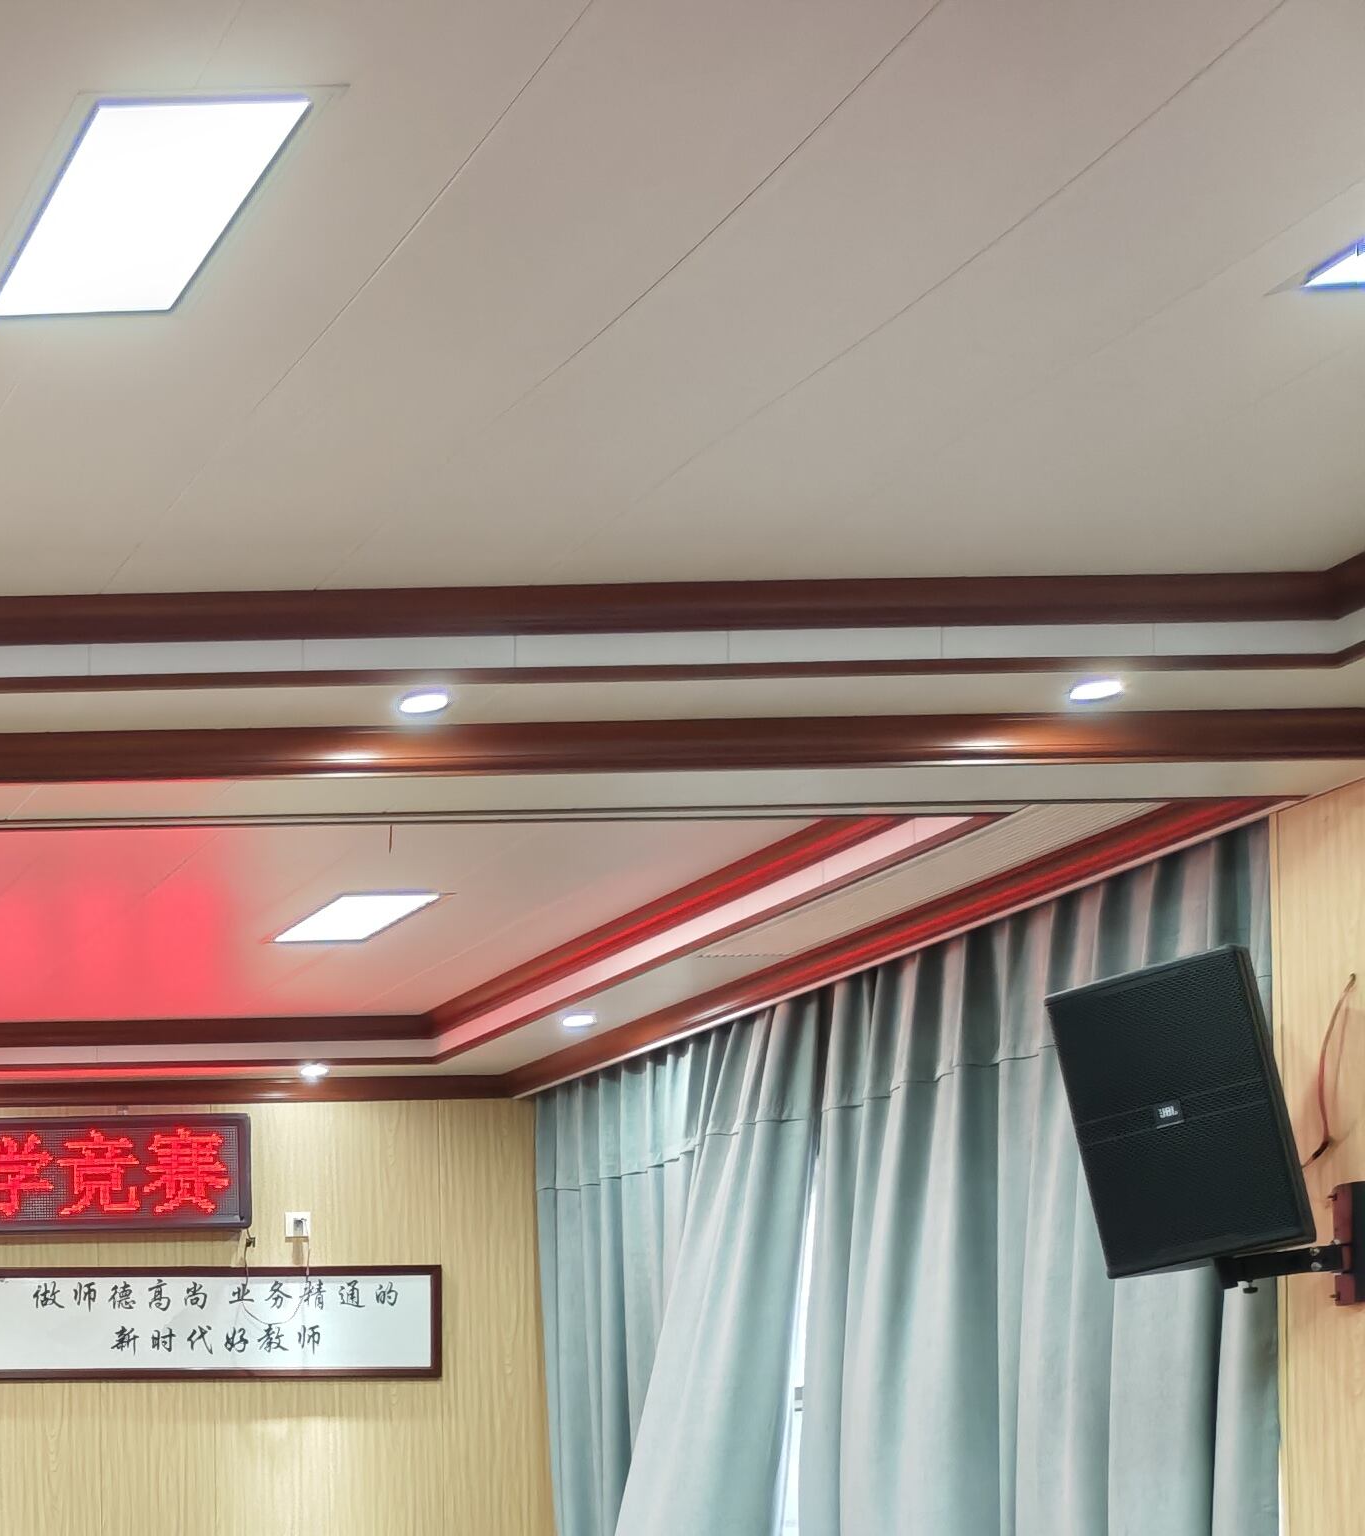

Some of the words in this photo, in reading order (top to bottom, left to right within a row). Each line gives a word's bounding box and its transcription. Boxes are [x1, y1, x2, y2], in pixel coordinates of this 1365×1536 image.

[110, 1323, 322, 1355] 新时代好教师
